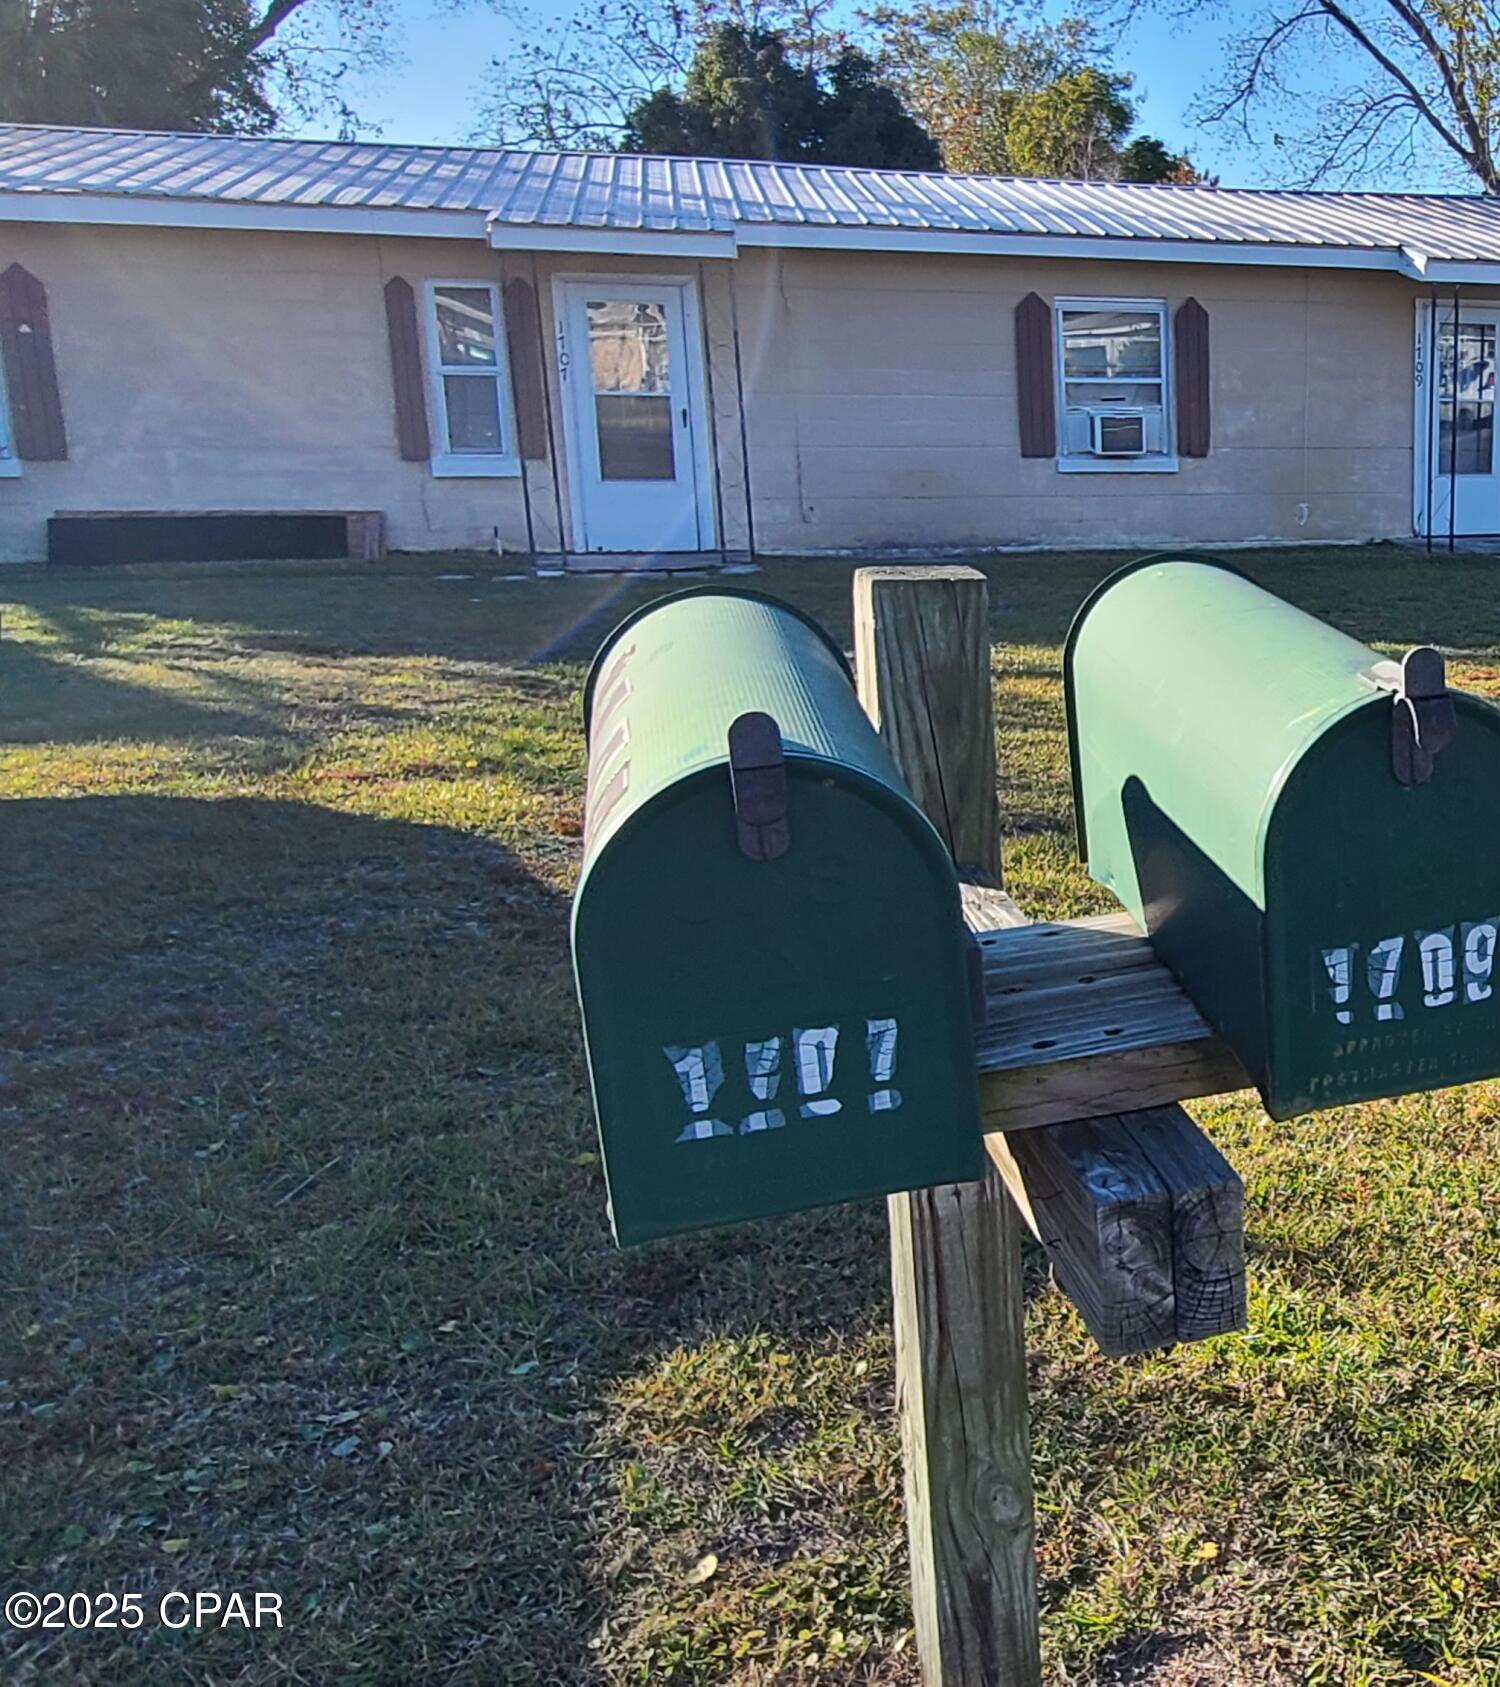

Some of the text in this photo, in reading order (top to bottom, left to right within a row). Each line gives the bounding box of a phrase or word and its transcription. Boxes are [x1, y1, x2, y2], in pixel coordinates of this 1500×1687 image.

[557, 319, 570, 382] 1707
[1415, 332, 1424, 388] 1709
[1321, 920, 1500, 1026] 1709
[667, 1017, 900, 1140] 1707
